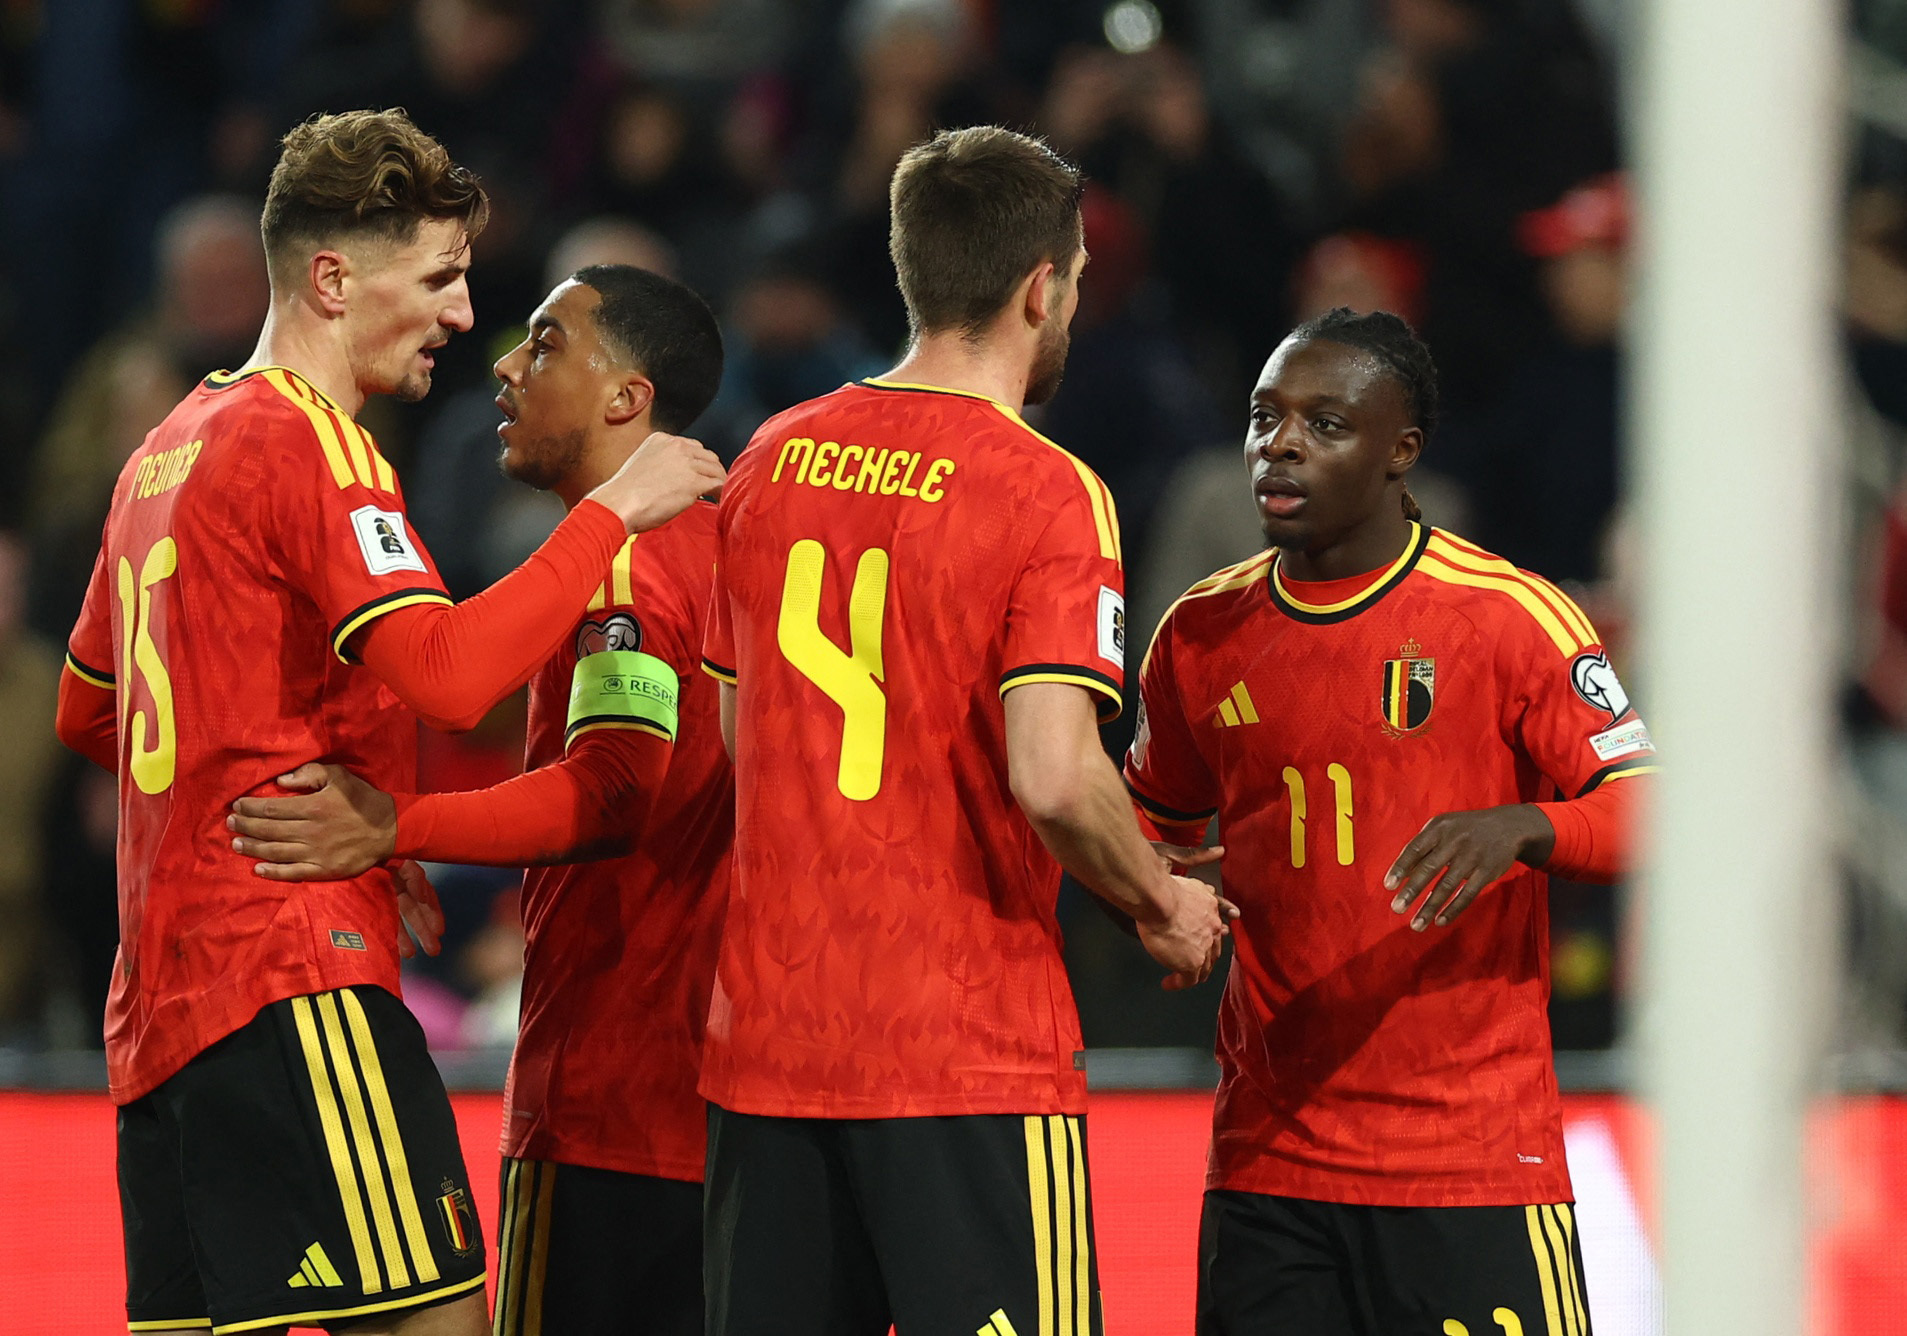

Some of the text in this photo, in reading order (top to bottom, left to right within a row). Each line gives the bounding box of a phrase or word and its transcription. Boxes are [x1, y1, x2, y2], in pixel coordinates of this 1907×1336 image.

[127, 439, 204, 504] MEUNIER
[771, 437, 957, 504] MECHELE
[117, 535, 178, 795] 15
[776, 539, 889, 802] 4
[1282, 762, 1355, 868] 11
